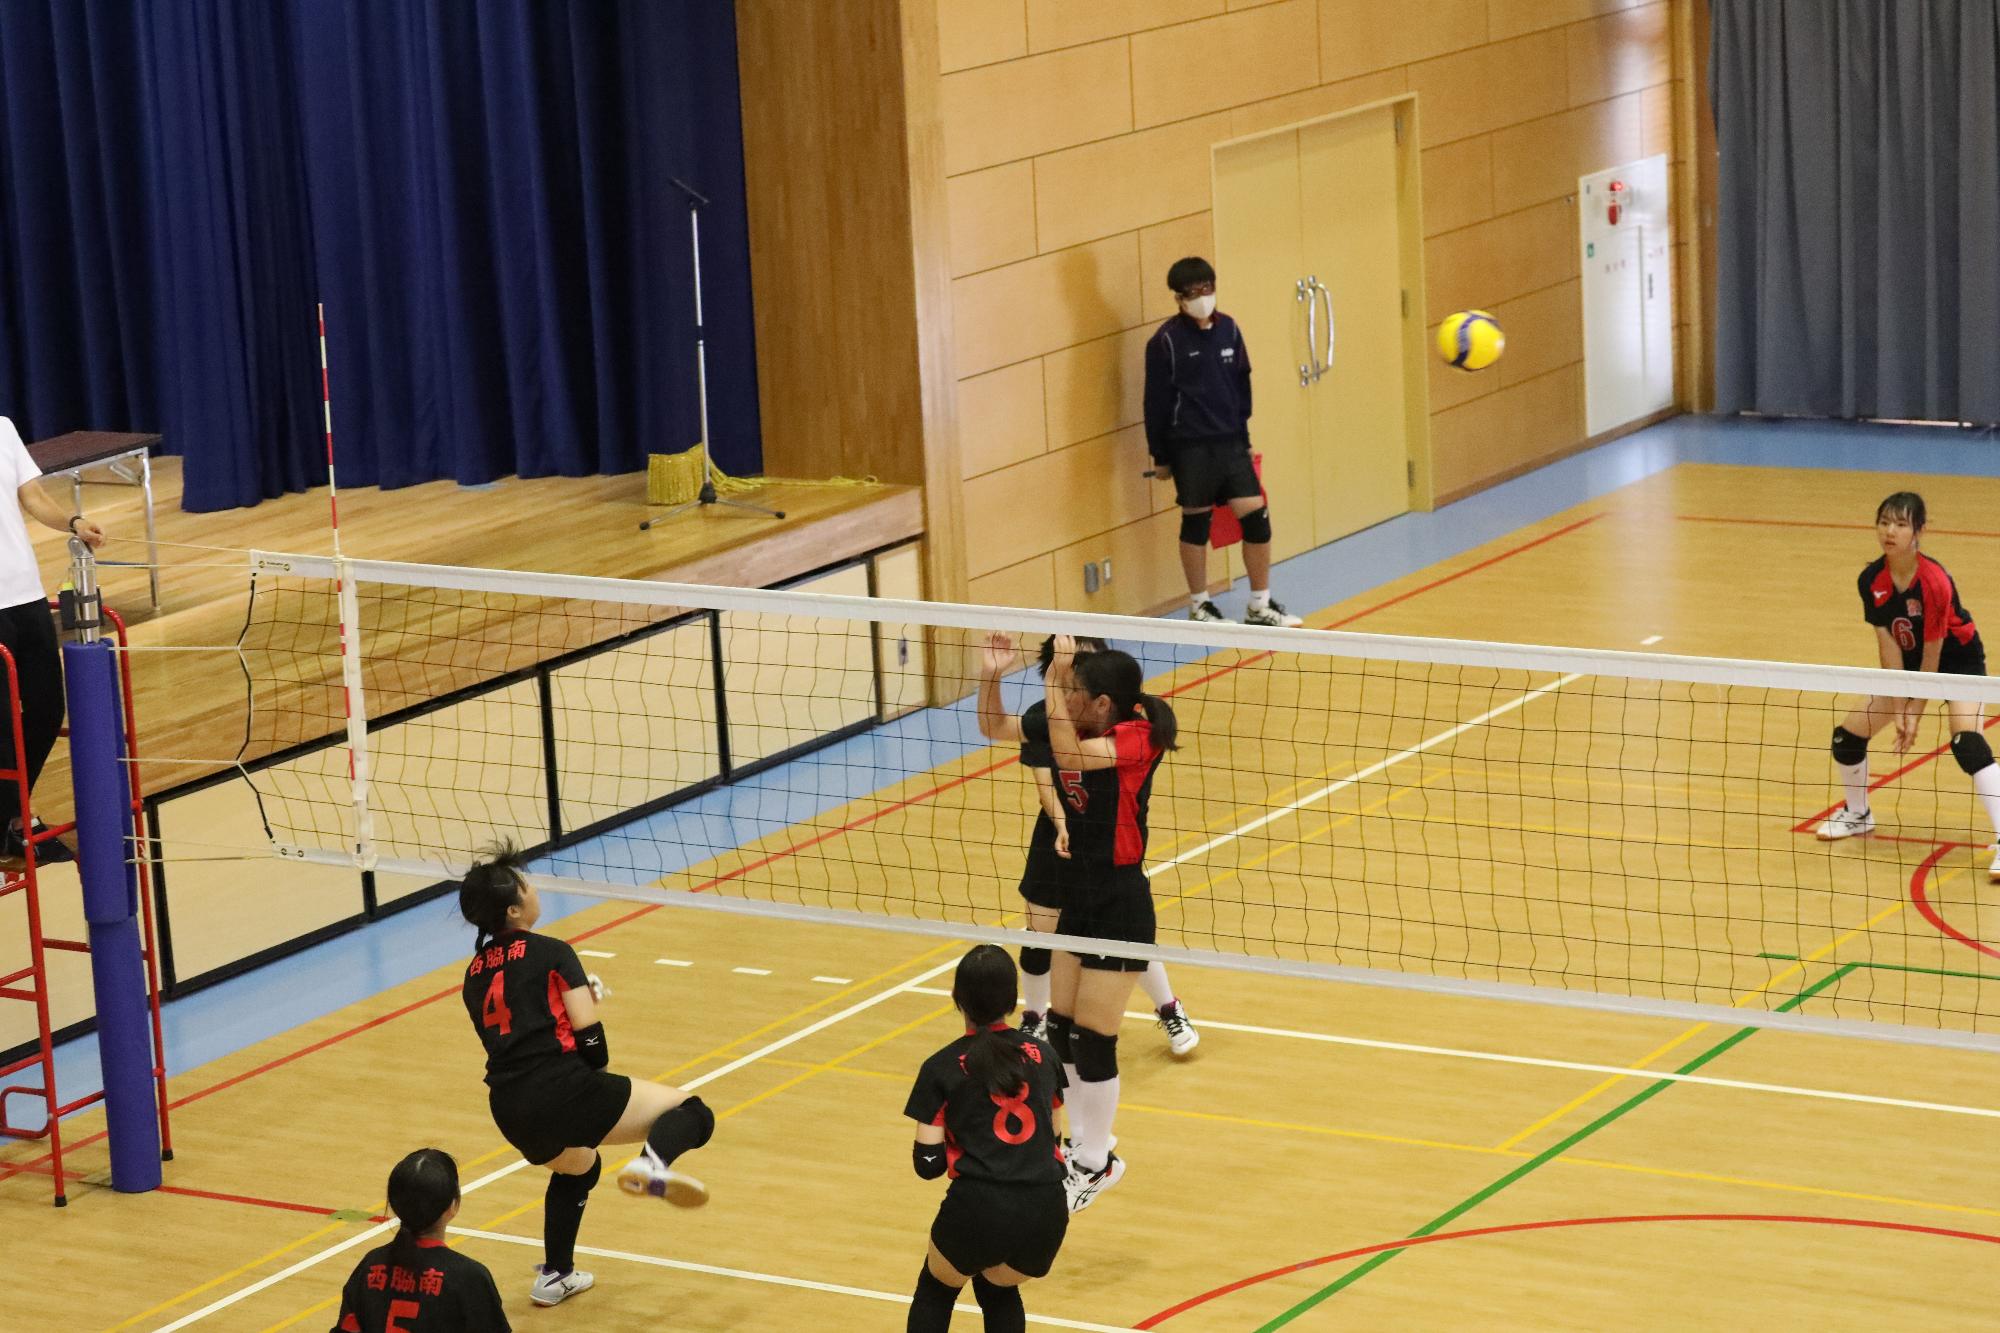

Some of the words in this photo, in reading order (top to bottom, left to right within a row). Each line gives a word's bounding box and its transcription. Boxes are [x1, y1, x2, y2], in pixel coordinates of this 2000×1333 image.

[1891, 617, 1916, 650] 6
[1058, 770, 1089, 814] 5
[482, 970, 512, 1035] 4
[989, 1080, 1036, 1145] 8
